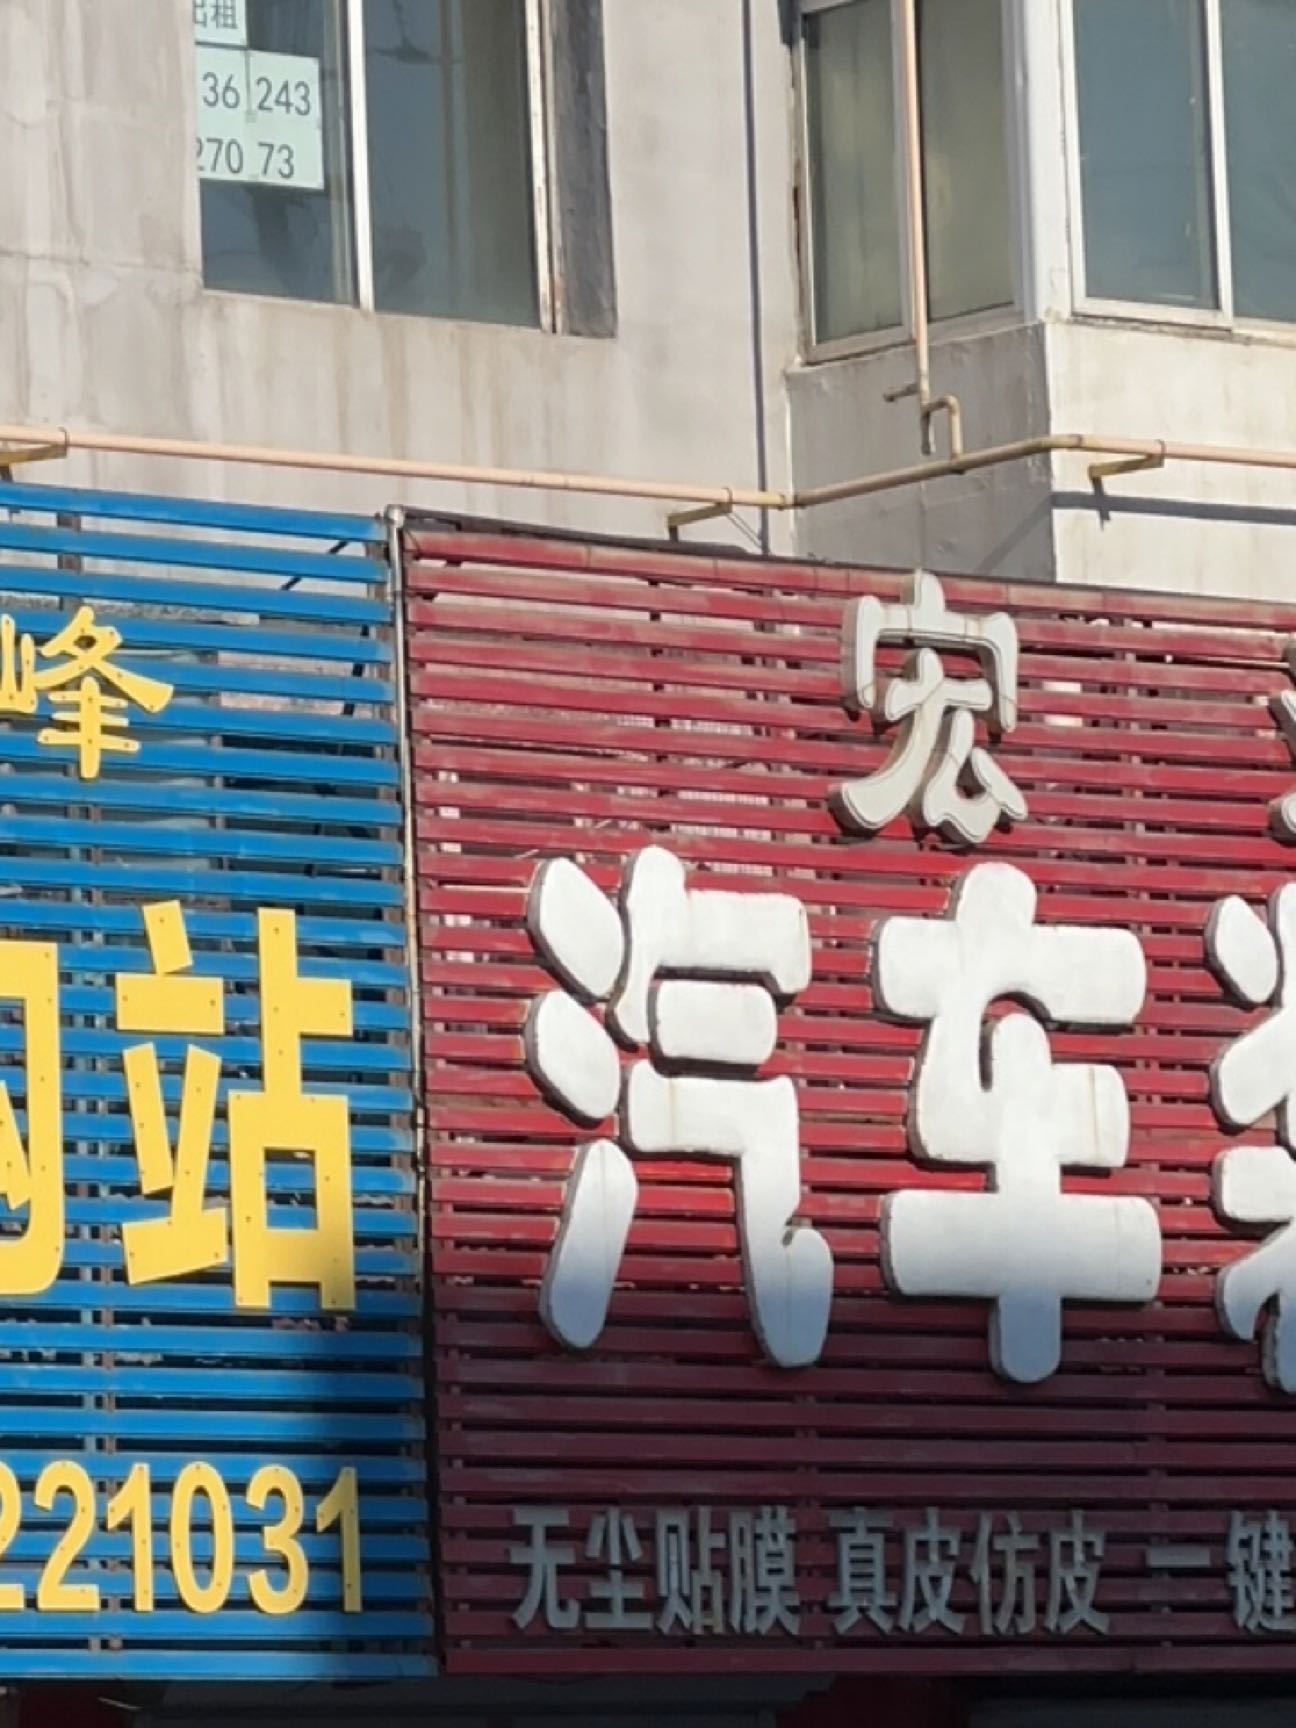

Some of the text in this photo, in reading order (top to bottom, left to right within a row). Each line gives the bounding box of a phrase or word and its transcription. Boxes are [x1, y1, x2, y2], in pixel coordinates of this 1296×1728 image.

[201, 70, 311, 116] 36 243
[256, 140, 295, 179] 73
[829, 568, 1029, 846] 宏
[508, 1505, 801, 1636] 无尘贴膜
[827, 1507, 1110, 1636] 真皮仿皮
